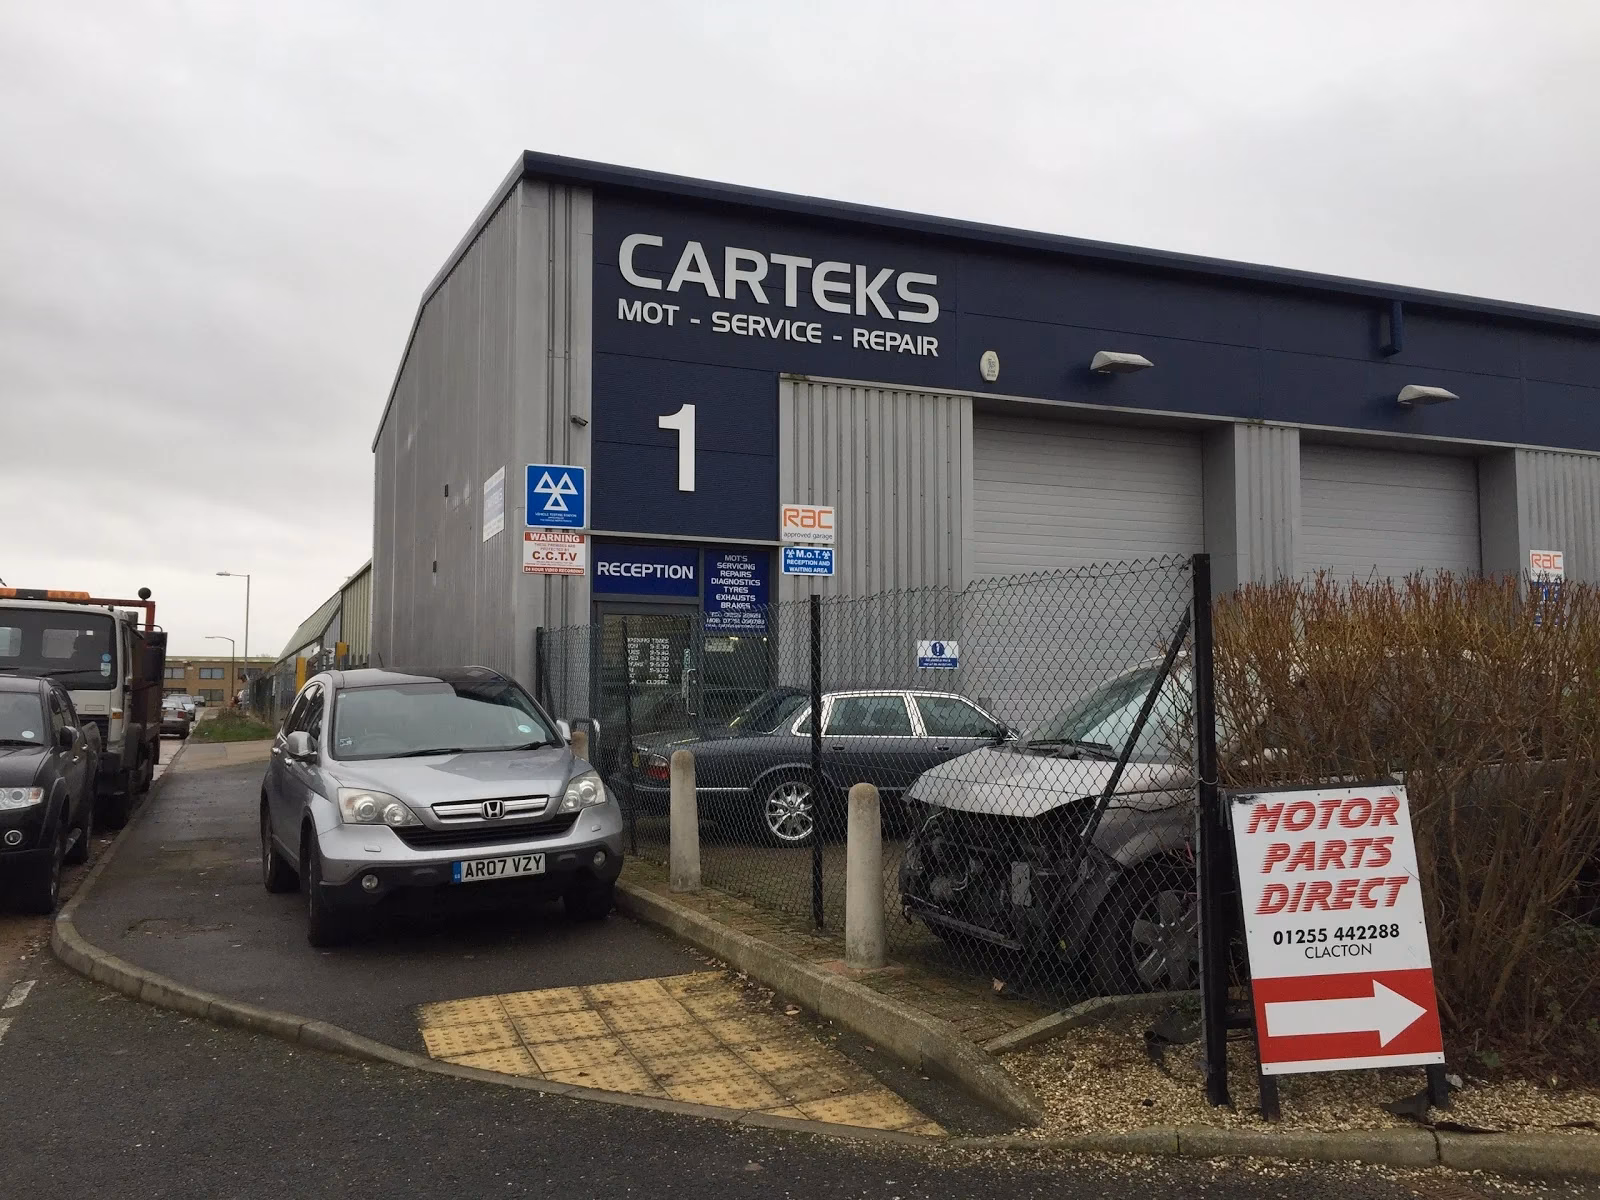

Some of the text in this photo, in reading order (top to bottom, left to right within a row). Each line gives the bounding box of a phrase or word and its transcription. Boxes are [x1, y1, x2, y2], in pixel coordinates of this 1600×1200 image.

[619, 233, 939, 324] CARTEKS
[618, 298, 680, 326] MOT
[712, 310, 822, 344] SERVICE
[853, 328, 938, 357] REPAIR
[658, 403, 695, 492] 1
[530, 532, 580, 543] WARNING
[812, 532, 832, 540] garage
[532, 551, 577, 561] C.C.T.V
[717, 562, 755, 570] SERVICING
[598, 561, 694, 579] RECEPTION
[720, 570, 752, 578] REPAIRS
[711, 578, 760, 586] DIAGNOSTICS
[1246, 796, 1400, 834] MOTOR
[1260, 836, 1394, 874] PARTS
[465, 859, 507, 878] AR07
[512, 855, 542, 872] VZY
[1254, 875, 1409, 915] DIRECT
[1273, 924, 1400, 946] 01255 442288
[1304, 943, 1372, 960] CLACTON
